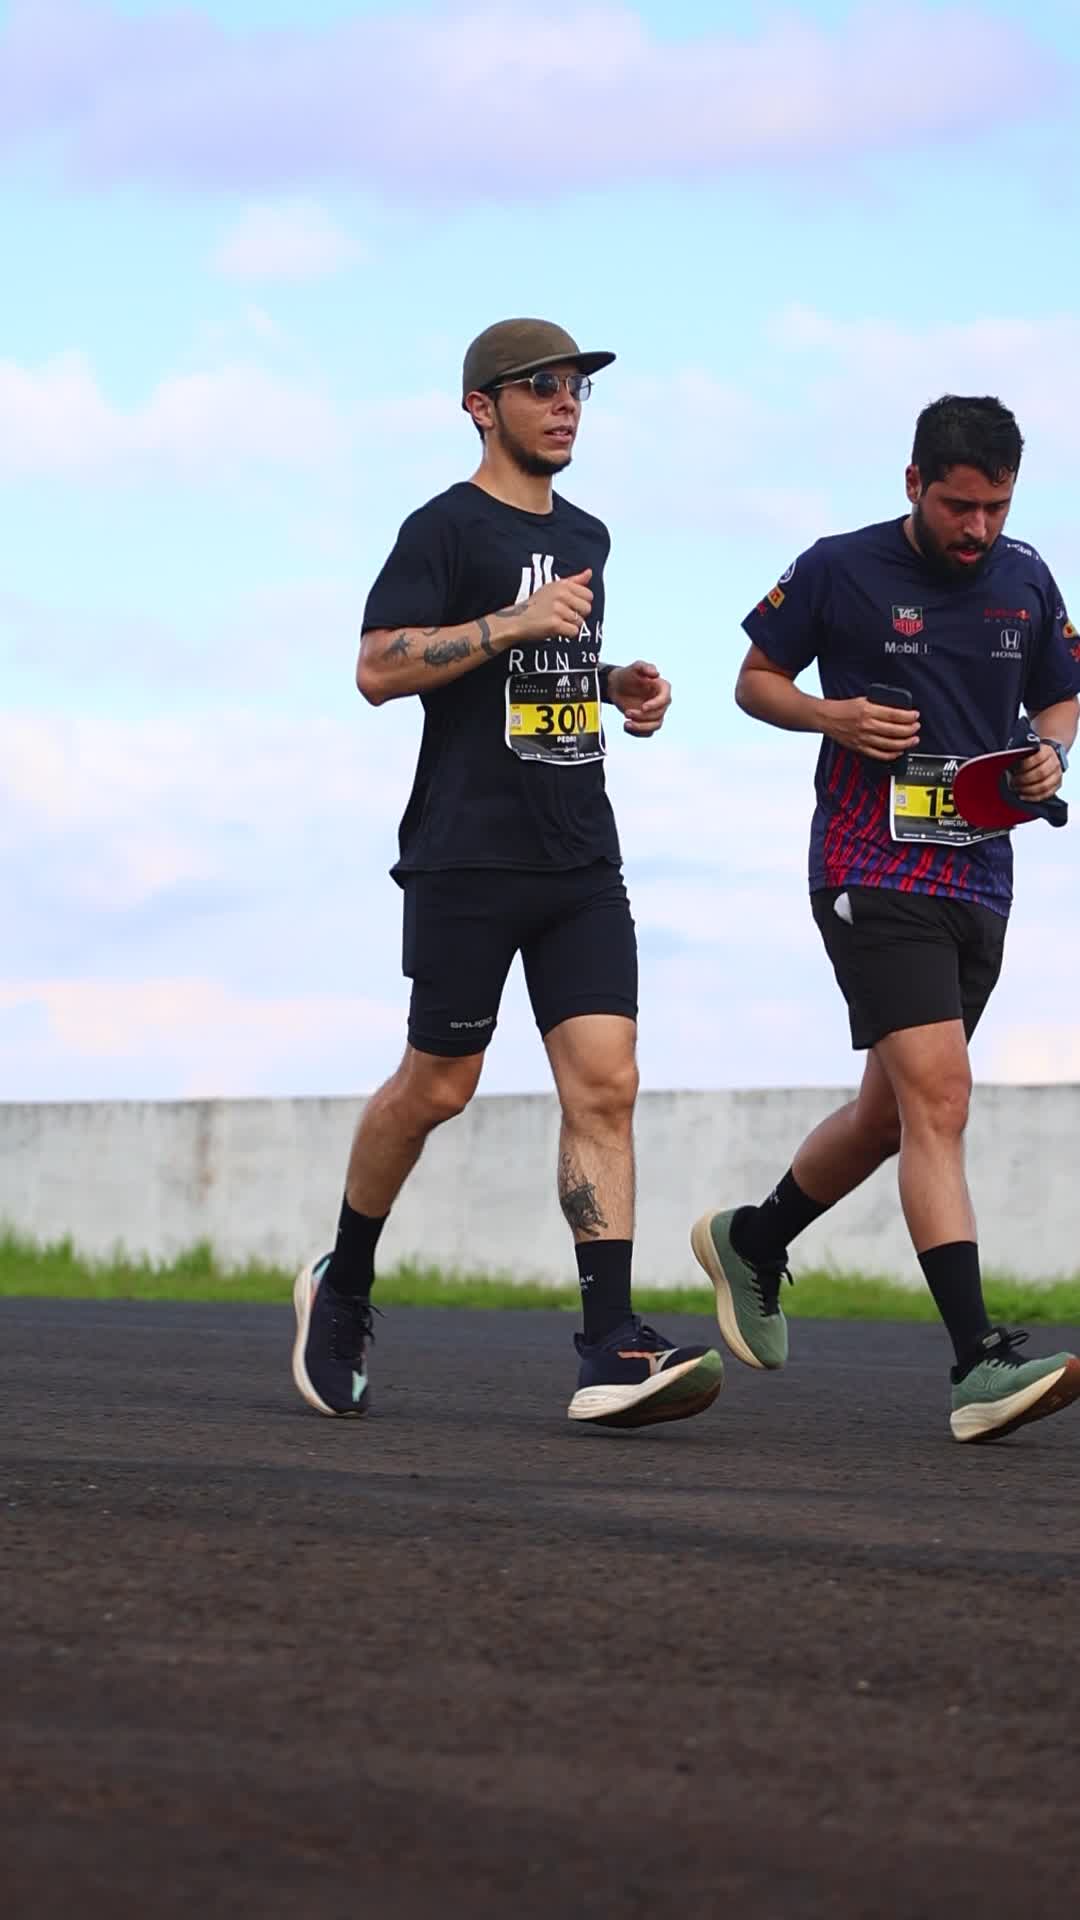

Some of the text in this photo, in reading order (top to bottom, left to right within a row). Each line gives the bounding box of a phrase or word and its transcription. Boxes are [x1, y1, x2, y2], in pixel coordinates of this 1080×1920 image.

[897, 607, 918, 620] TAG
[884, 641, 919, 655] Mobil
[508, 649, 570, 673] RUN
[534, 704, 587, 735] 300
